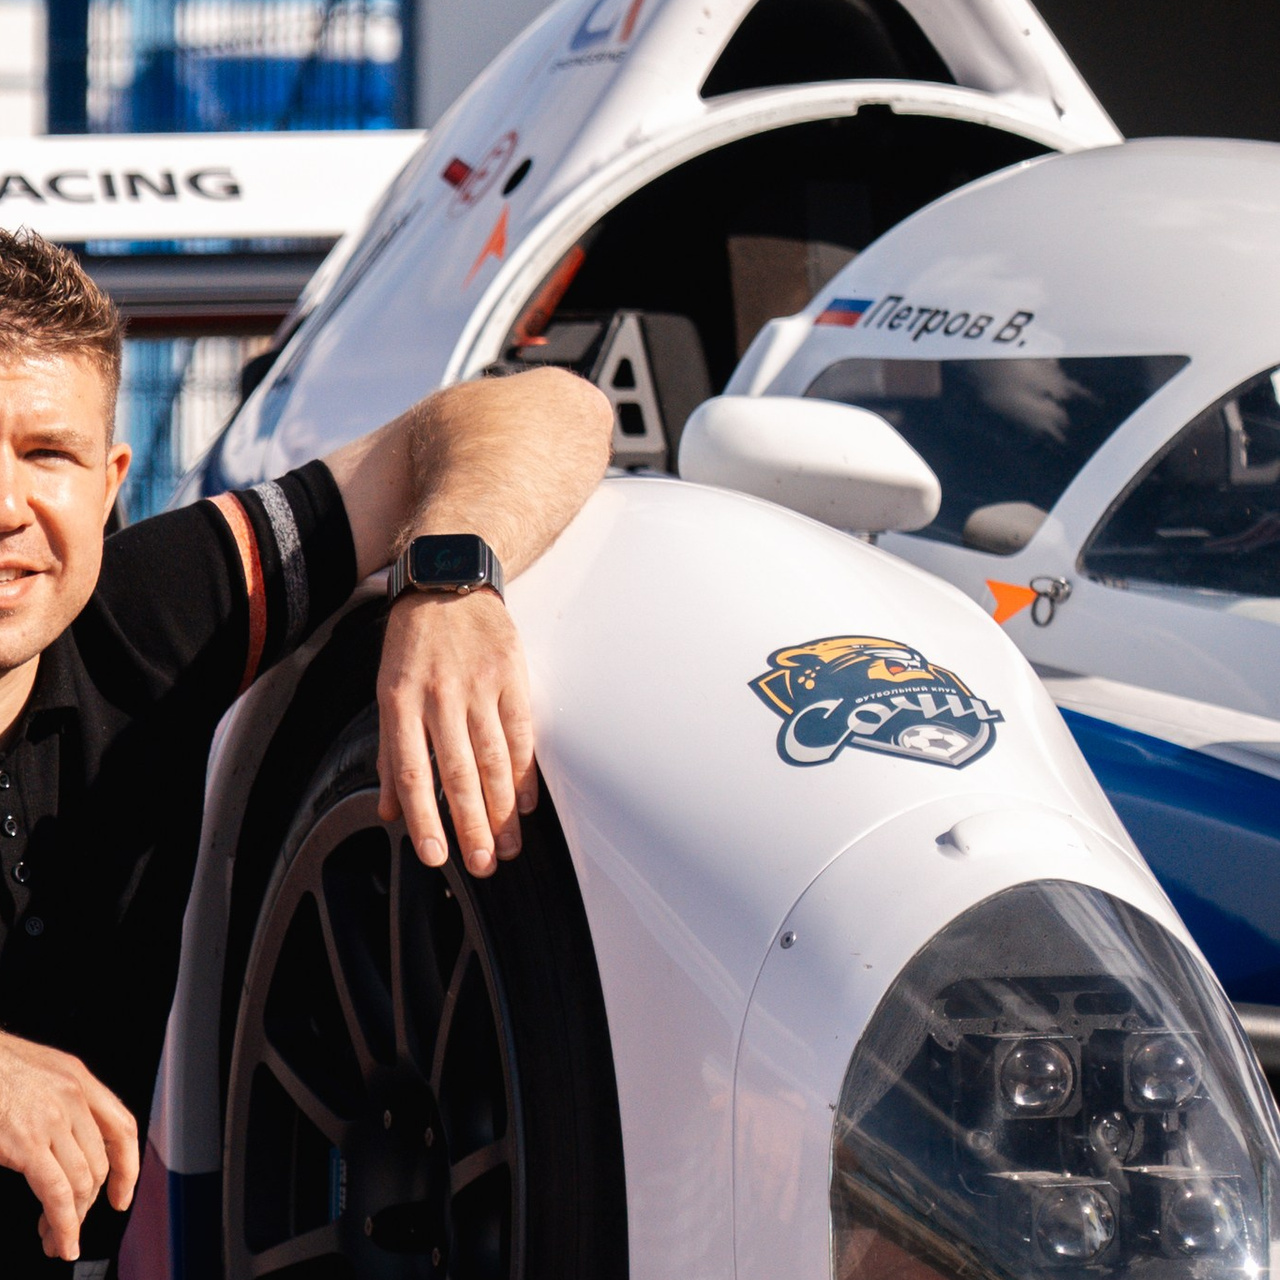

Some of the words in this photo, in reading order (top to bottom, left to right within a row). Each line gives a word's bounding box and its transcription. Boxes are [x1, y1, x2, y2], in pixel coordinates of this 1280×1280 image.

[864, 295, 994, 341] Петров
[992, 310, 1034, 347] В.
[855, 685, 928, 704] ФУТБОЛЬНЫЙ
[931, 686, 957, 694] КЛУБ
